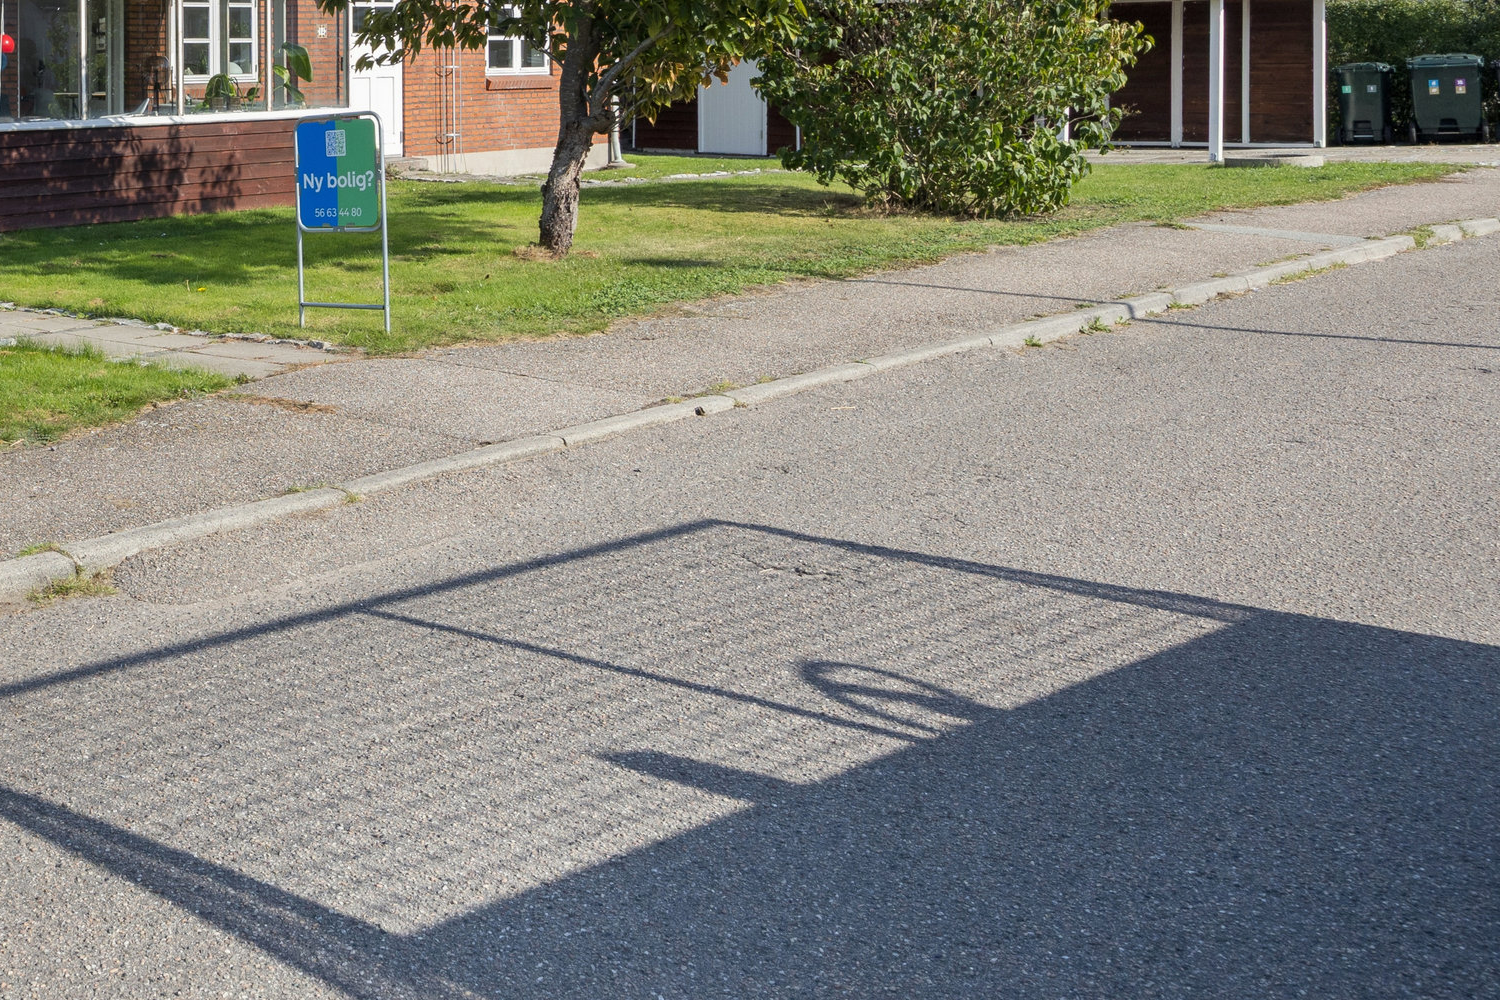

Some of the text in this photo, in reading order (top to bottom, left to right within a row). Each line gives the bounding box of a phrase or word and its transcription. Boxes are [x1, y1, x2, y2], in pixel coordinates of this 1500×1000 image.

[303, 170, 375, 193] Ny bolig?
[314, 207, 362, 218] 56 63 44 80
